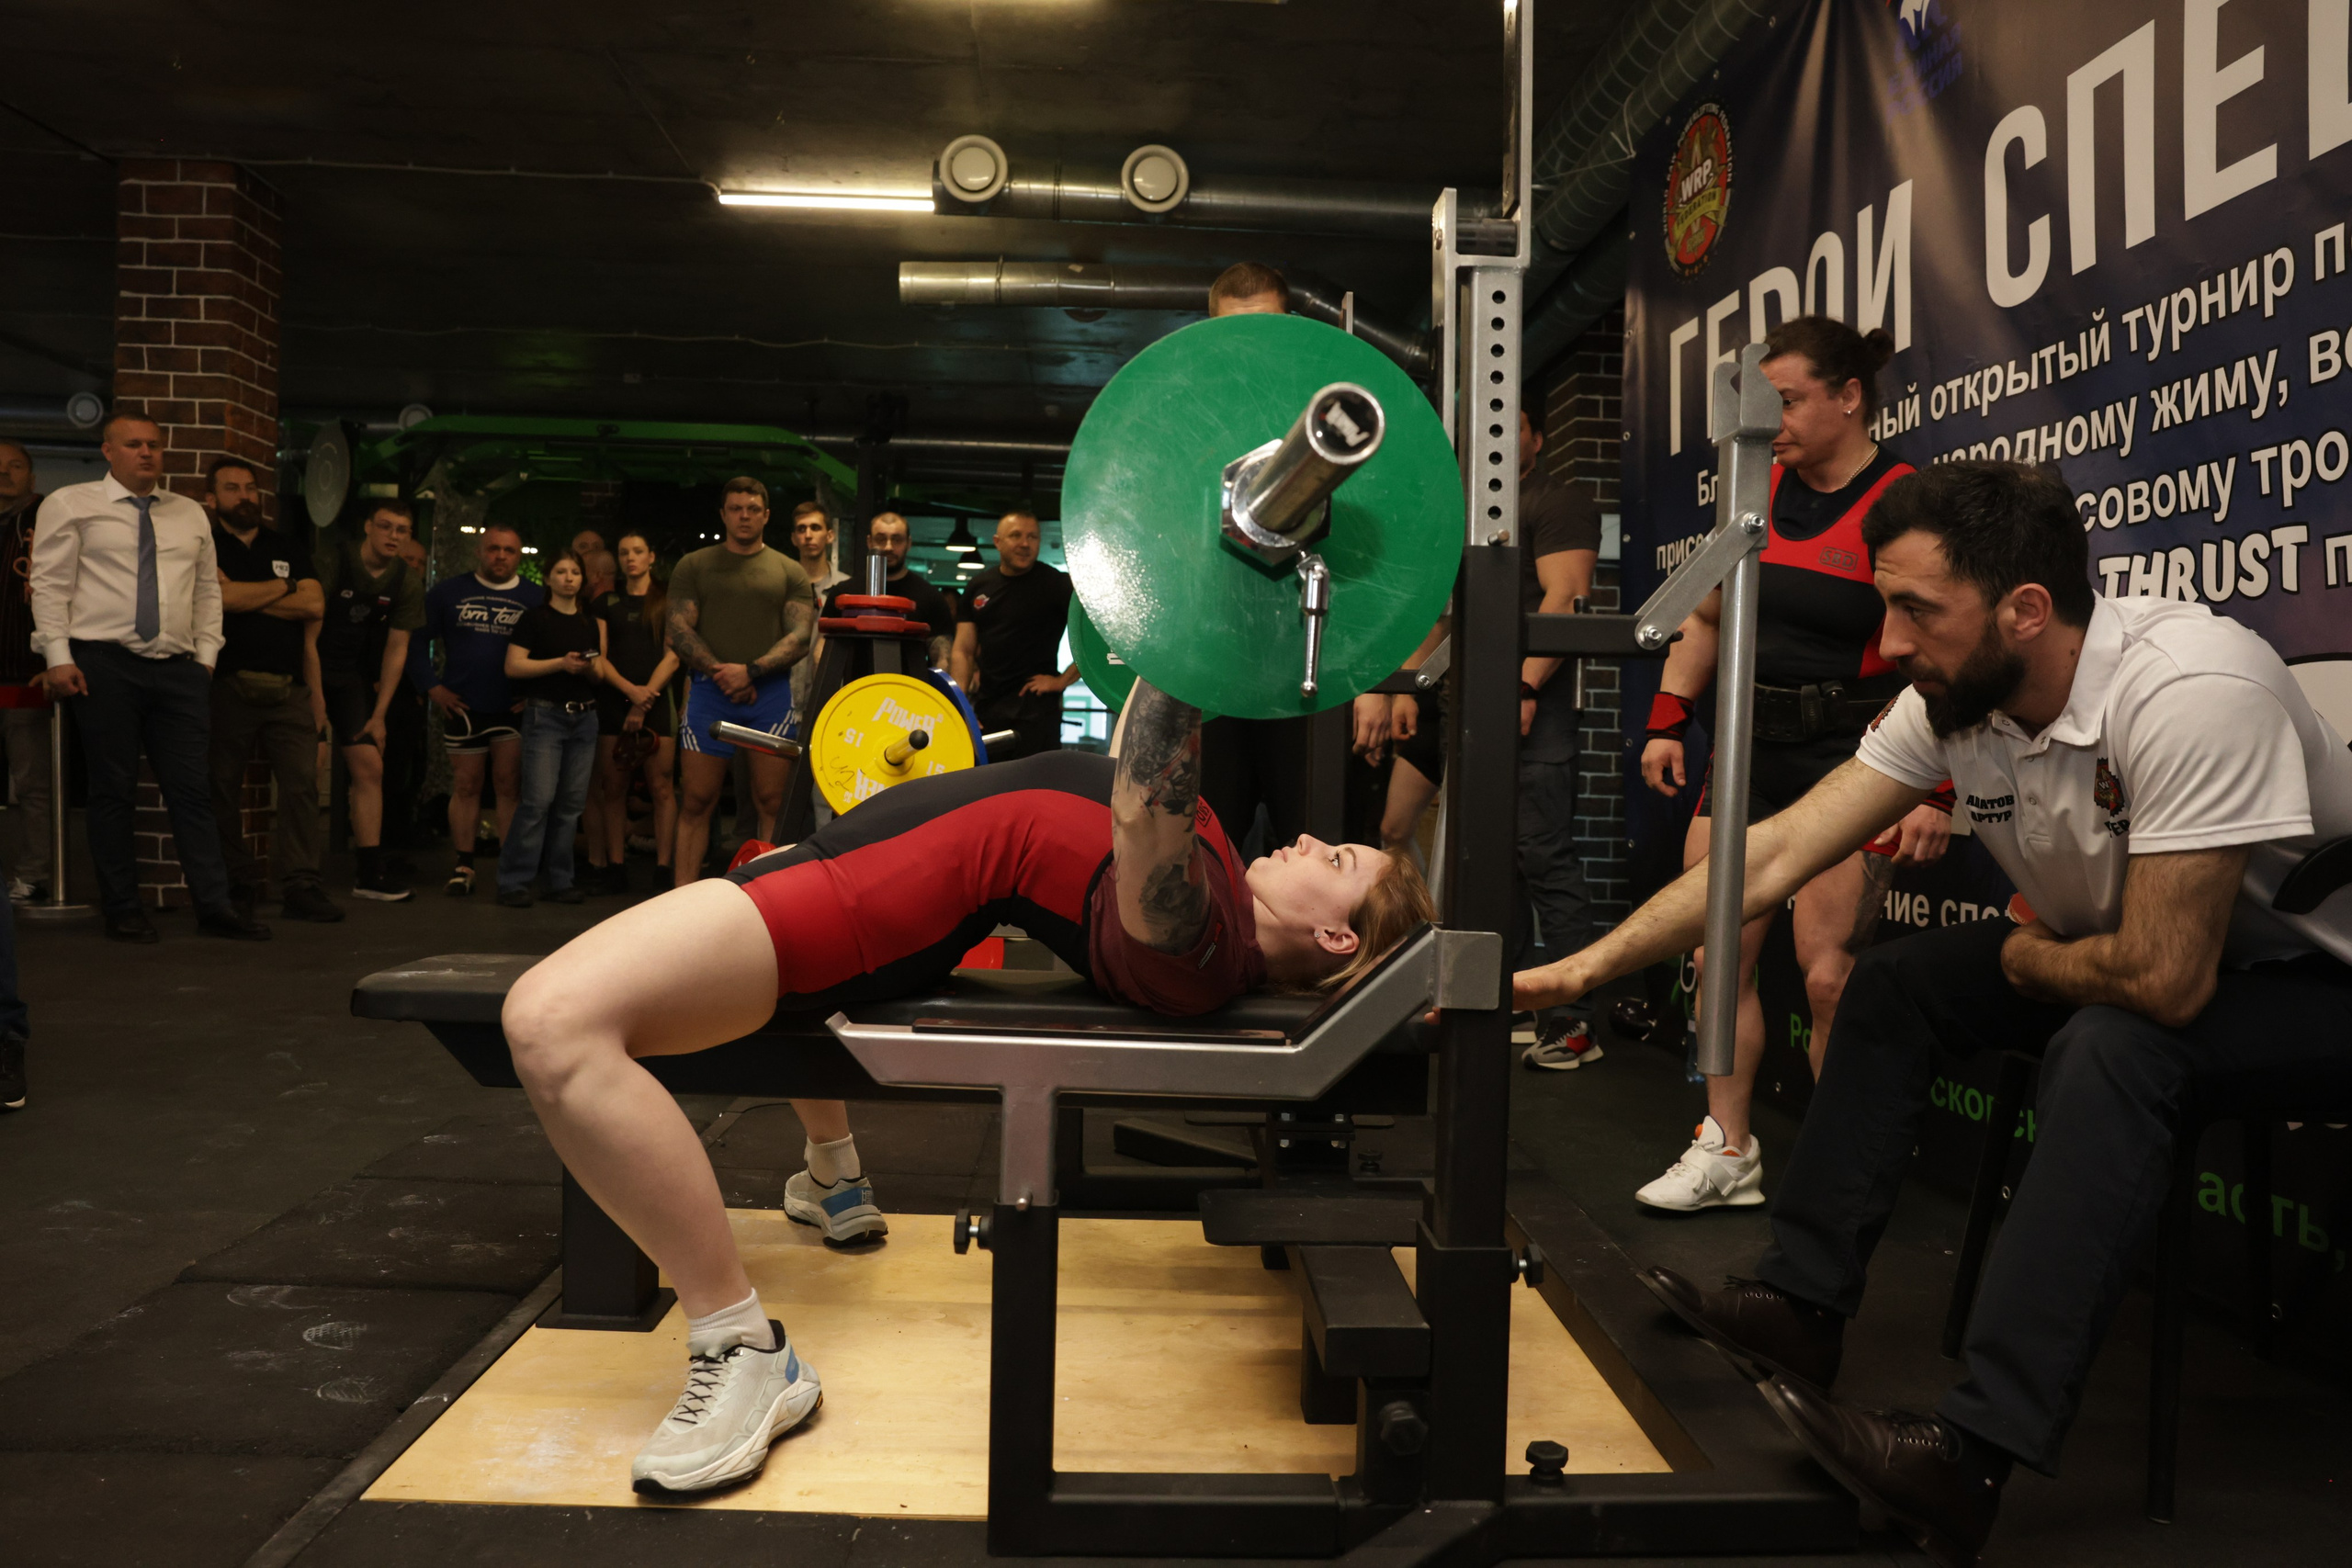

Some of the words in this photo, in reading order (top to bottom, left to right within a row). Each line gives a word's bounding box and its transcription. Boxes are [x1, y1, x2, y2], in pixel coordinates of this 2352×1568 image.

[1681, 157, 1713, 203] WRP
[1669, 178, 1913, 457] ГЕРОИ
[1868, 382, 1921, 442] ный
[1929, 308, 2111, 417] открытый
[2121, 246, 2295, 363] турнир
[2315, 221, 2352, 282] п
[1657, 533, 1704, 576] присе
[2150, 347, 2289, 433] жиму,
[2309, 323, 2352, 384] в
[2075, 456, 2237, 533] совому
[2250, 430, 2352, 509] тро
[1822, 549, 1855, 569] SBD
[2098, 524, 2309, 604] THRUST
[2324, 534, 2352, 589] п
[456, 602, 489, 623] Tom
[492, 605, 525, 626] Tail
[871, 696, 938, 747] POWER
[1881, 889, 1930, 928] ние
[1940, 899, 2002, 928] спо
[2197, 1171, 2346, 1274] асть,
